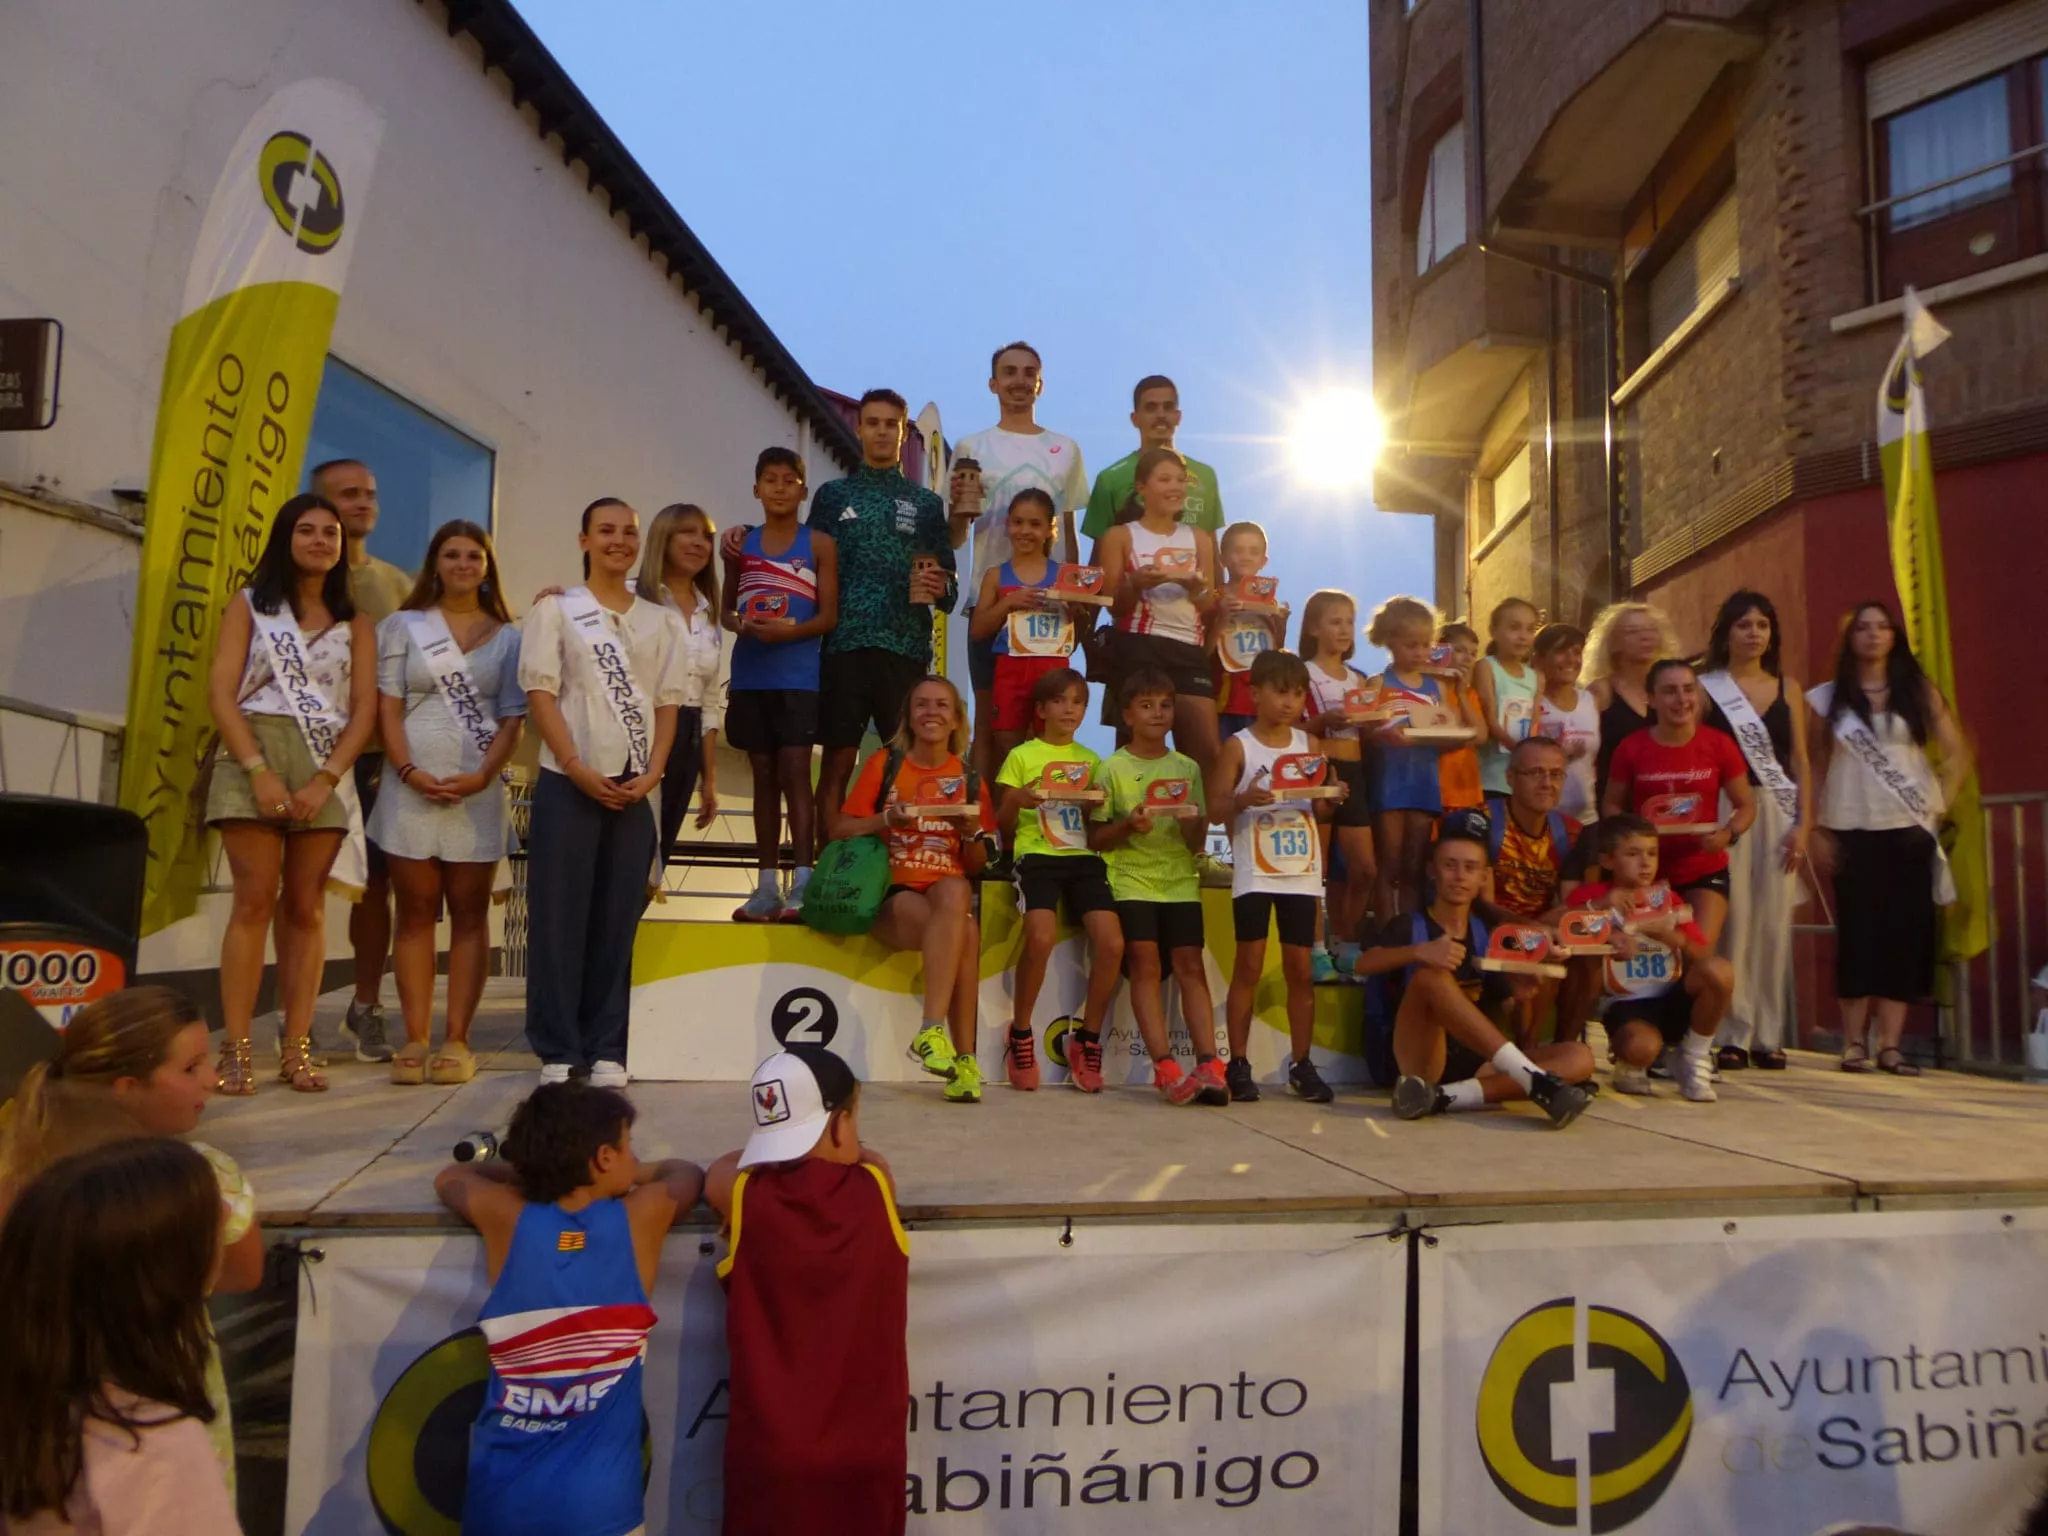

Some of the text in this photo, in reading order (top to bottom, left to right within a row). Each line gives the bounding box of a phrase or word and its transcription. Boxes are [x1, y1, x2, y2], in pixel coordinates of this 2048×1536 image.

[1025, 614, 1060, 638] 167
[1270, 829, 1308, 856] 133
[1625, 953, 1668, 978] 138
[785, 997, 823, 1042] 2
[685, 1371, 1308, 1439] Atamiento
[904, 1446, 1320, 1515] abiñánigo
